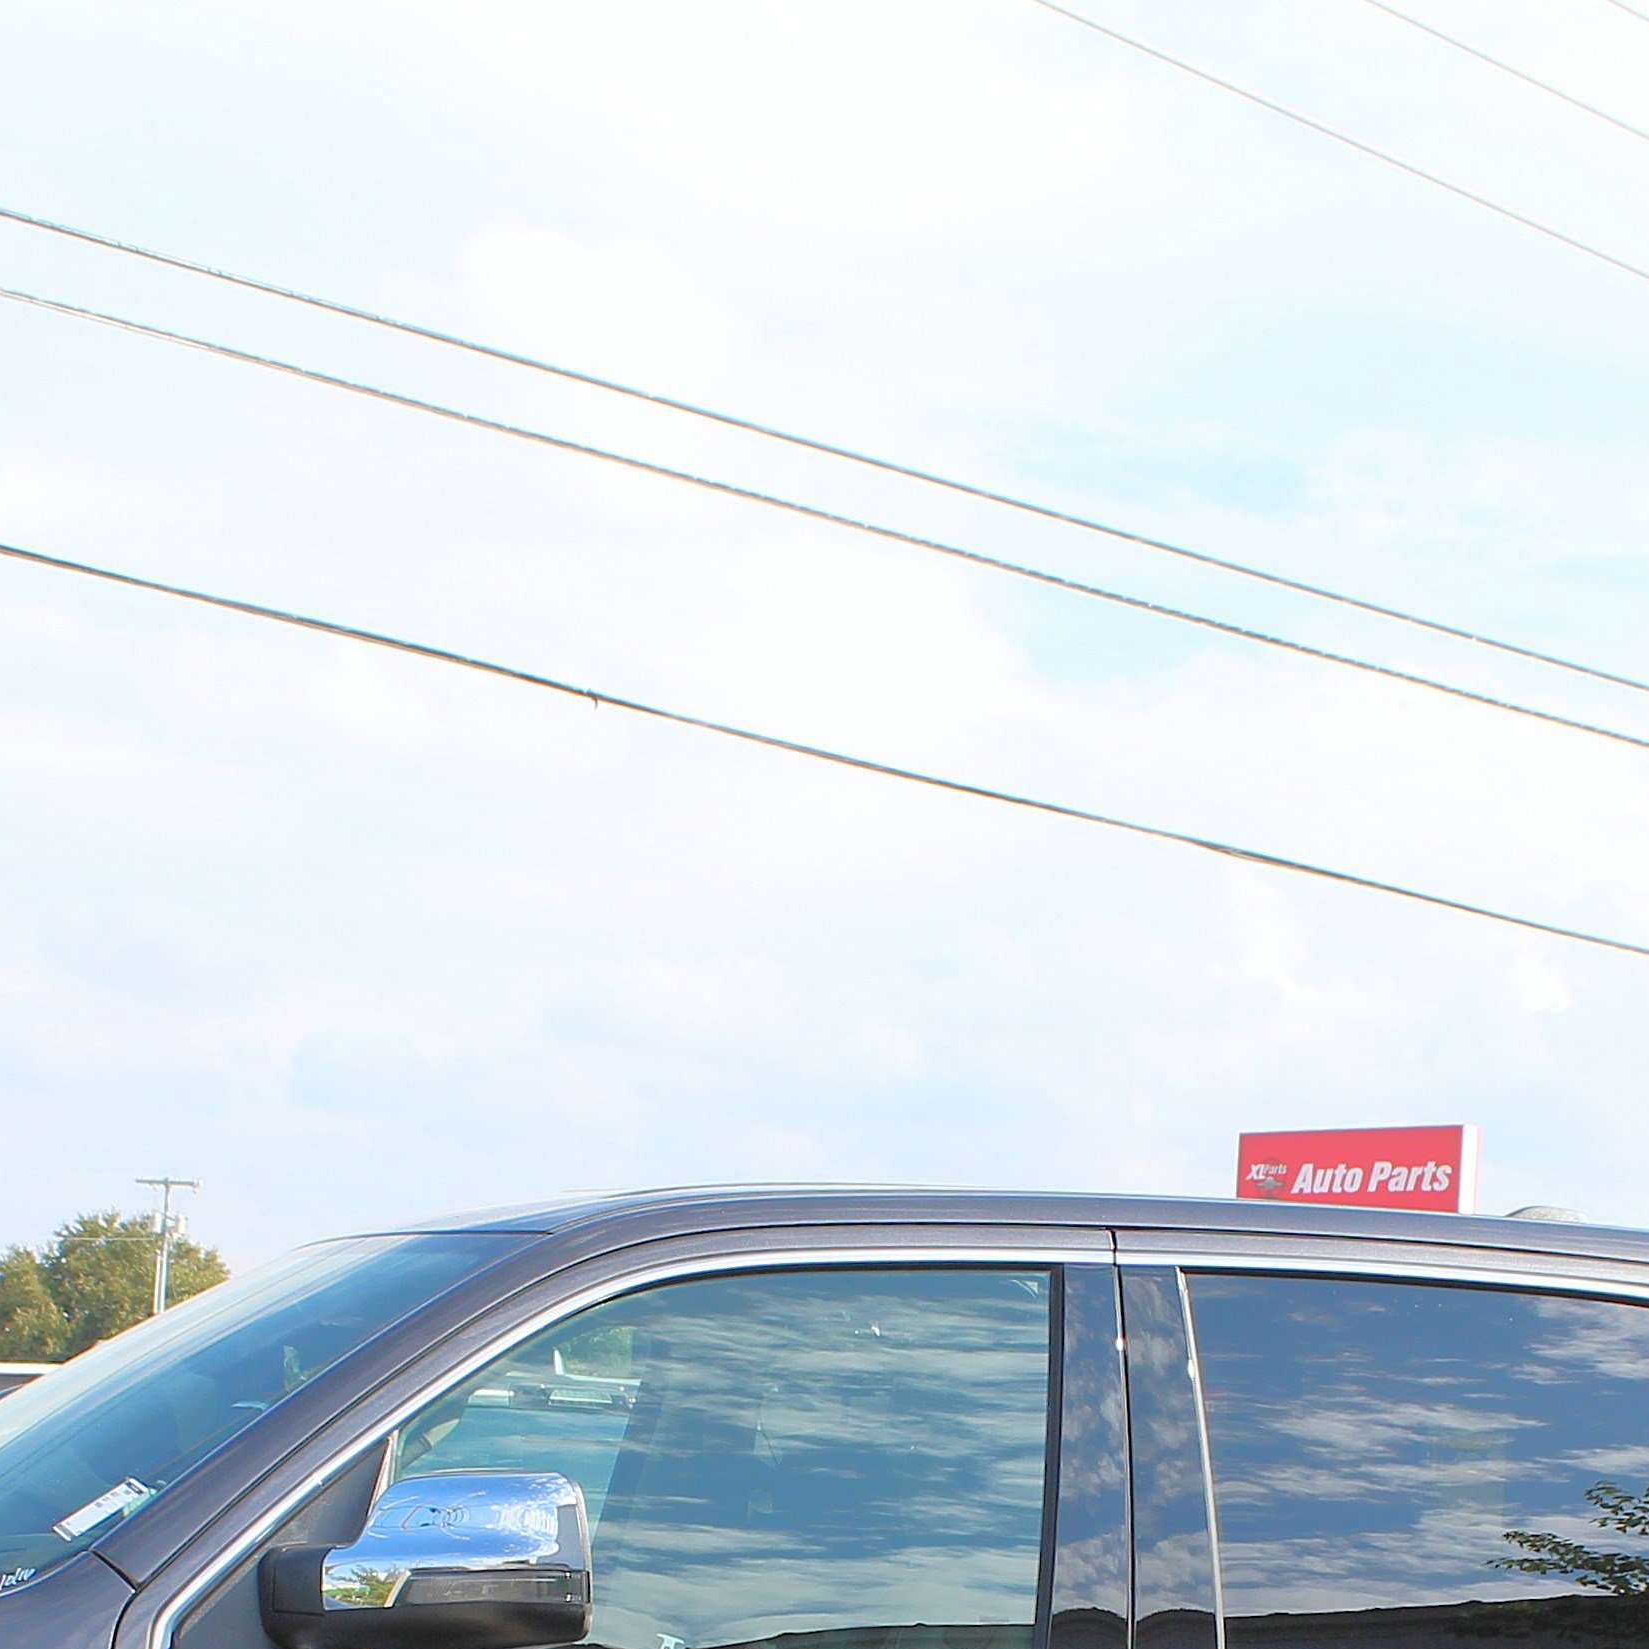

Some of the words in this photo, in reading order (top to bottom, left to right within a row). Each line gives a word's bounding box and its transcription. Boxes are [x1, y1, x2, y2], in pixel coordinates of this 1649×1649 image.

[1245, 1164, 1266, 1181] XL
[1291, 1162, 1364, 1194] Auto
[1367, 1160, 1453, 1193] Parts
